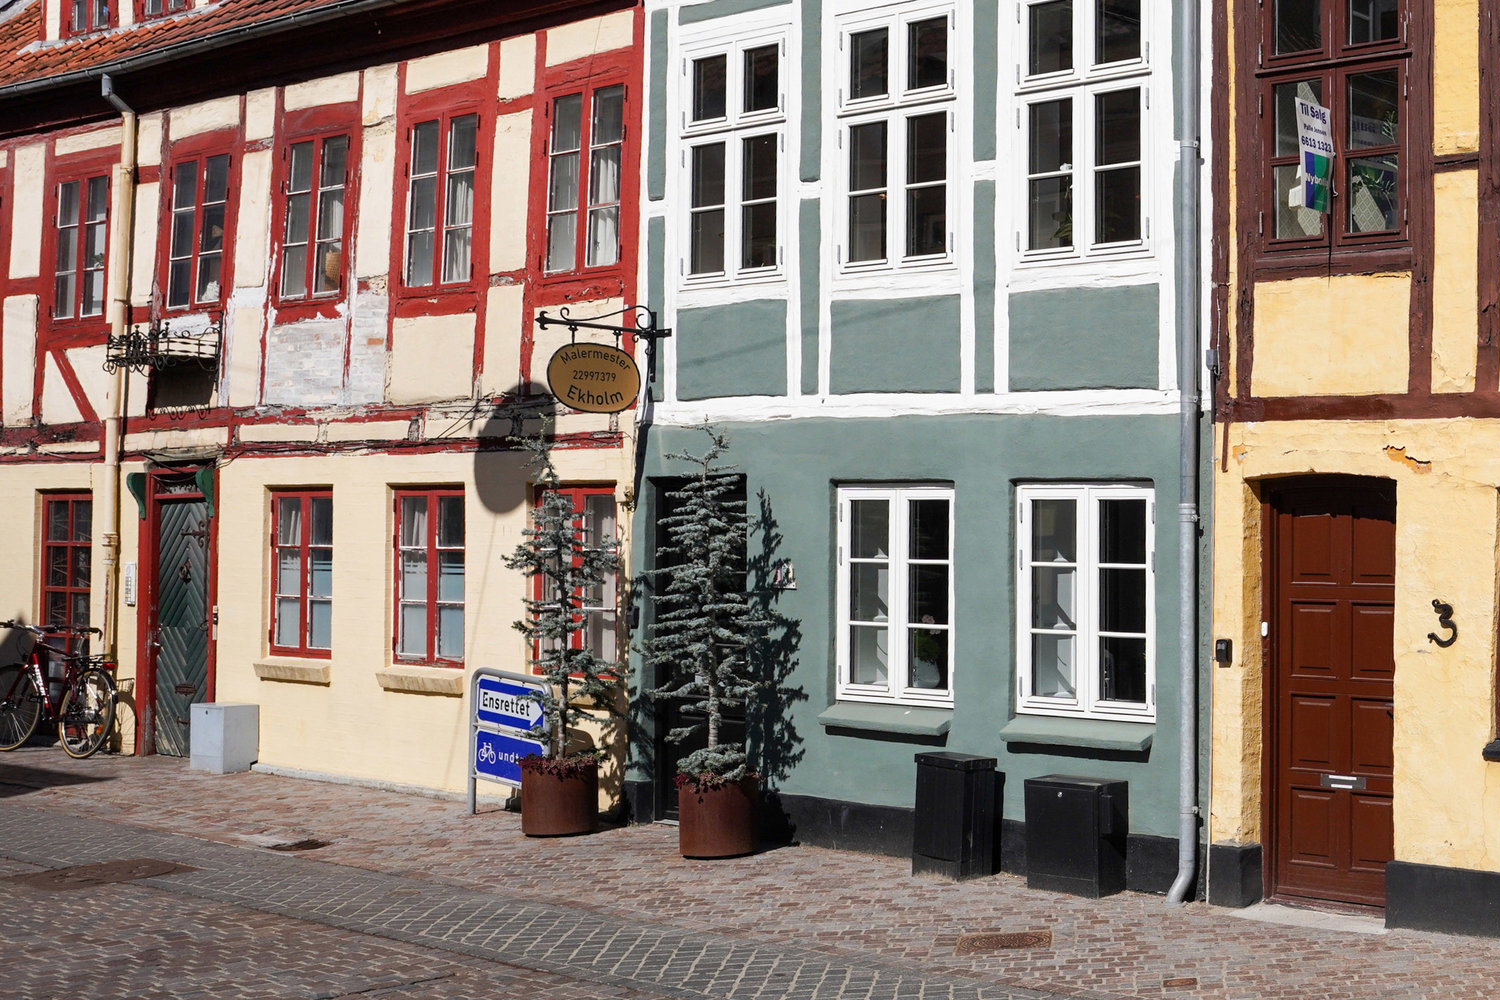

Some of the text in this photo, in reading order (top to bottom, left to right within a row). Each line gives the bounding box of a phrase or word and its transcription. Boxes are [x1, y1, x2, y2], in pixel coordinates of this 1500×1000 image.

[1300, 102, 1327, 124] Til Salg
[1301, 136, 1332, 153] 6613 1323
[560, 348, 631, 371] Malermester
[573, 369, 617, 382] 22997379
[566, 384, 624, 406] Ekholm
[1427, 598, 1458, 649] 3
[482, 691, 530, 717] Ensrettet
